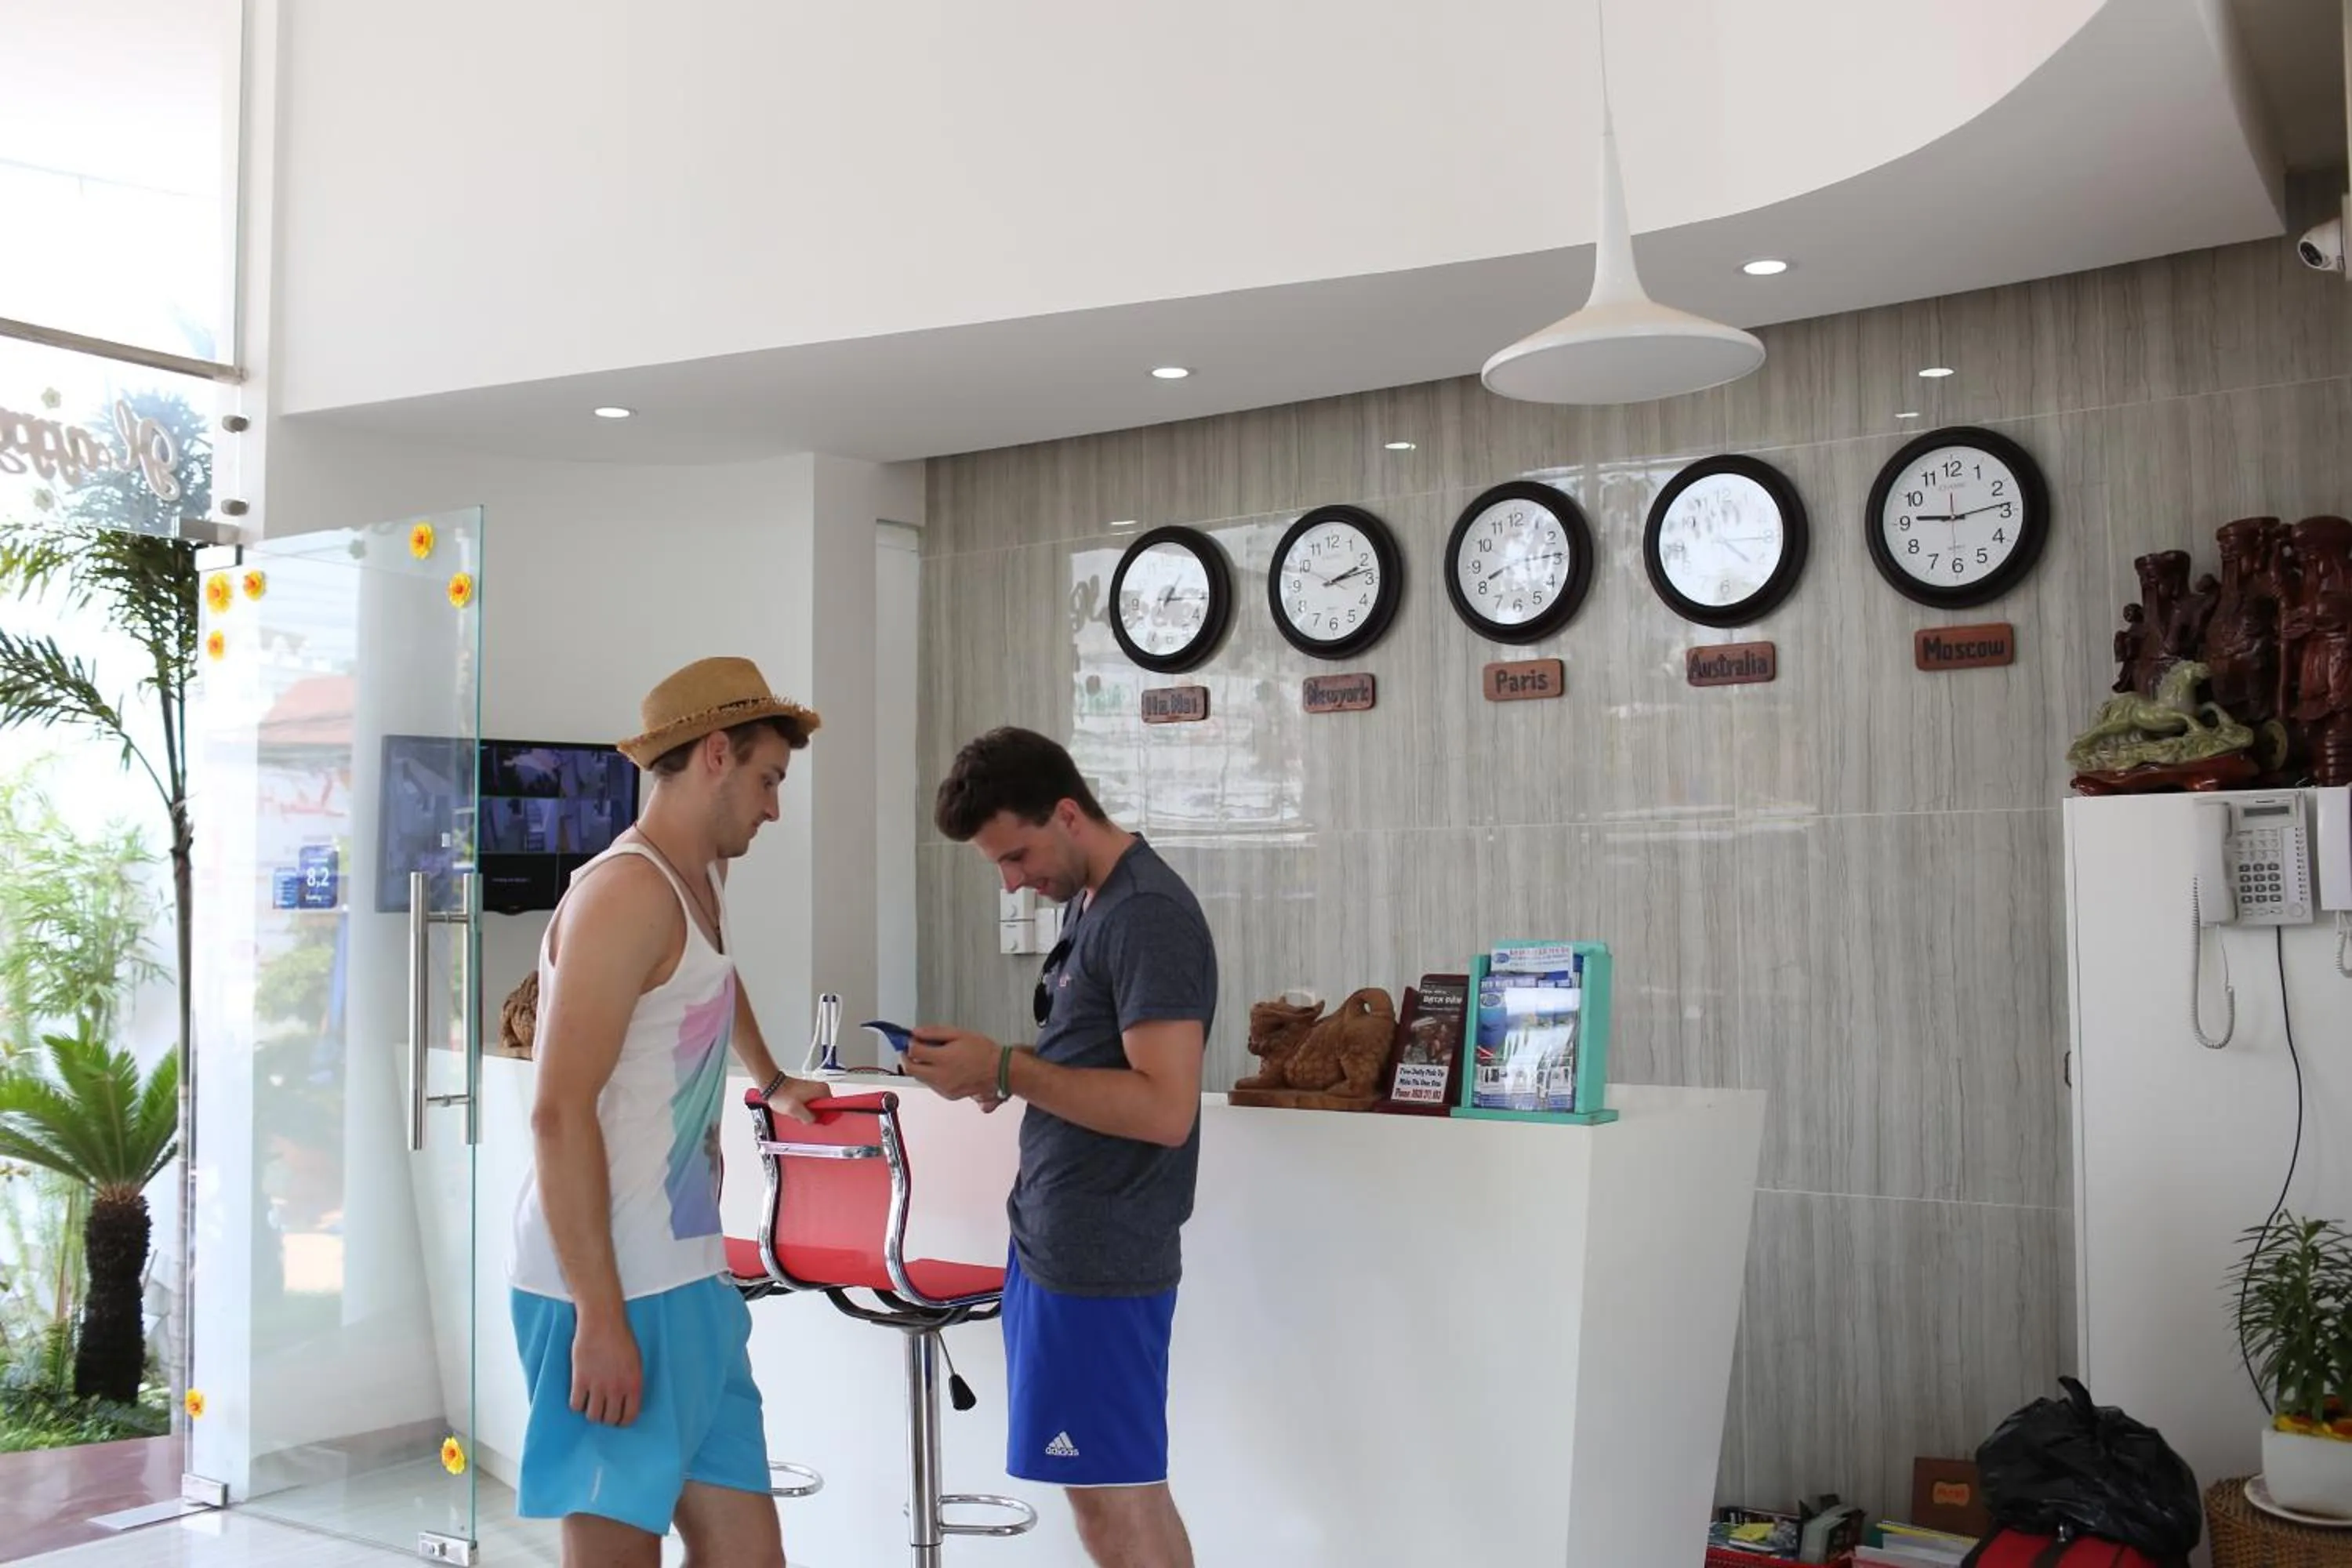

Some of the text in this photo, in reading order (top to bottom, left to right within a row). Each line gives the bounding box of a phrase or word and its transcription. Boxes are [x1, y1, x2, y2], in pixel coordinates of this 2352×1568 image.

[1942, 460, 1962, 477] 12
[1973, 464, 1981, 480] 1
[1921, 471, 1936, 487] 11
[1991, 481, 2004, 496] 2
[1906, 491, 1923, 507] 10
[2000, 502, 2013, 518] 3
[1508, 513, 1523, 527] 12
[1900, 516, 1911, 531] 9
[1491, 521, 1503, 535] 11
[1324, 535, 1340, 548] 12
[1547, 531, 1556, 545] 2
[1992, 528, 2005, 543] 4
[1310, 543, 1321, 556] 11
[1345, 539, 1353, 551] 1
[1477, 539, 1492, 552] 10
[1907, 539, 1920, 554] 8
[1359, 553, 1369, 567] 2
[1553, 553, 1562, 565] 3
[1927, 553, 1940, 570] 7
[1976, 547, 1987, 564] 5
[1299, 559, 1311, 573] 10
[1472, 560, 1481, 574] 9
[1951, 557, 1964, 573] 6
[1293, 579, 1301, 593] 9
[1365, 572, 1374, 586] 3
[1546, 573, 1555, 588] 4
[1478, 581, 1487, 594] 8
[1359, 593, 1368, 606] 4
[1494, 594, 1503, 609] 7
[1533, 590, 1542, 605] 5
[1298, 600, 1307, 613] 8
[1512, 599, 1523, 612] 6
[1312, 612, 1321, 627] 7
[1348, 609, 1356, 622] 5
[1329, 617, 1338, 630] 6
[1923, 636, 2005, 662] Moscow
[1495, 669, 1548, 695] Paris
[1046, 1446, 1080, 1456] adidas
